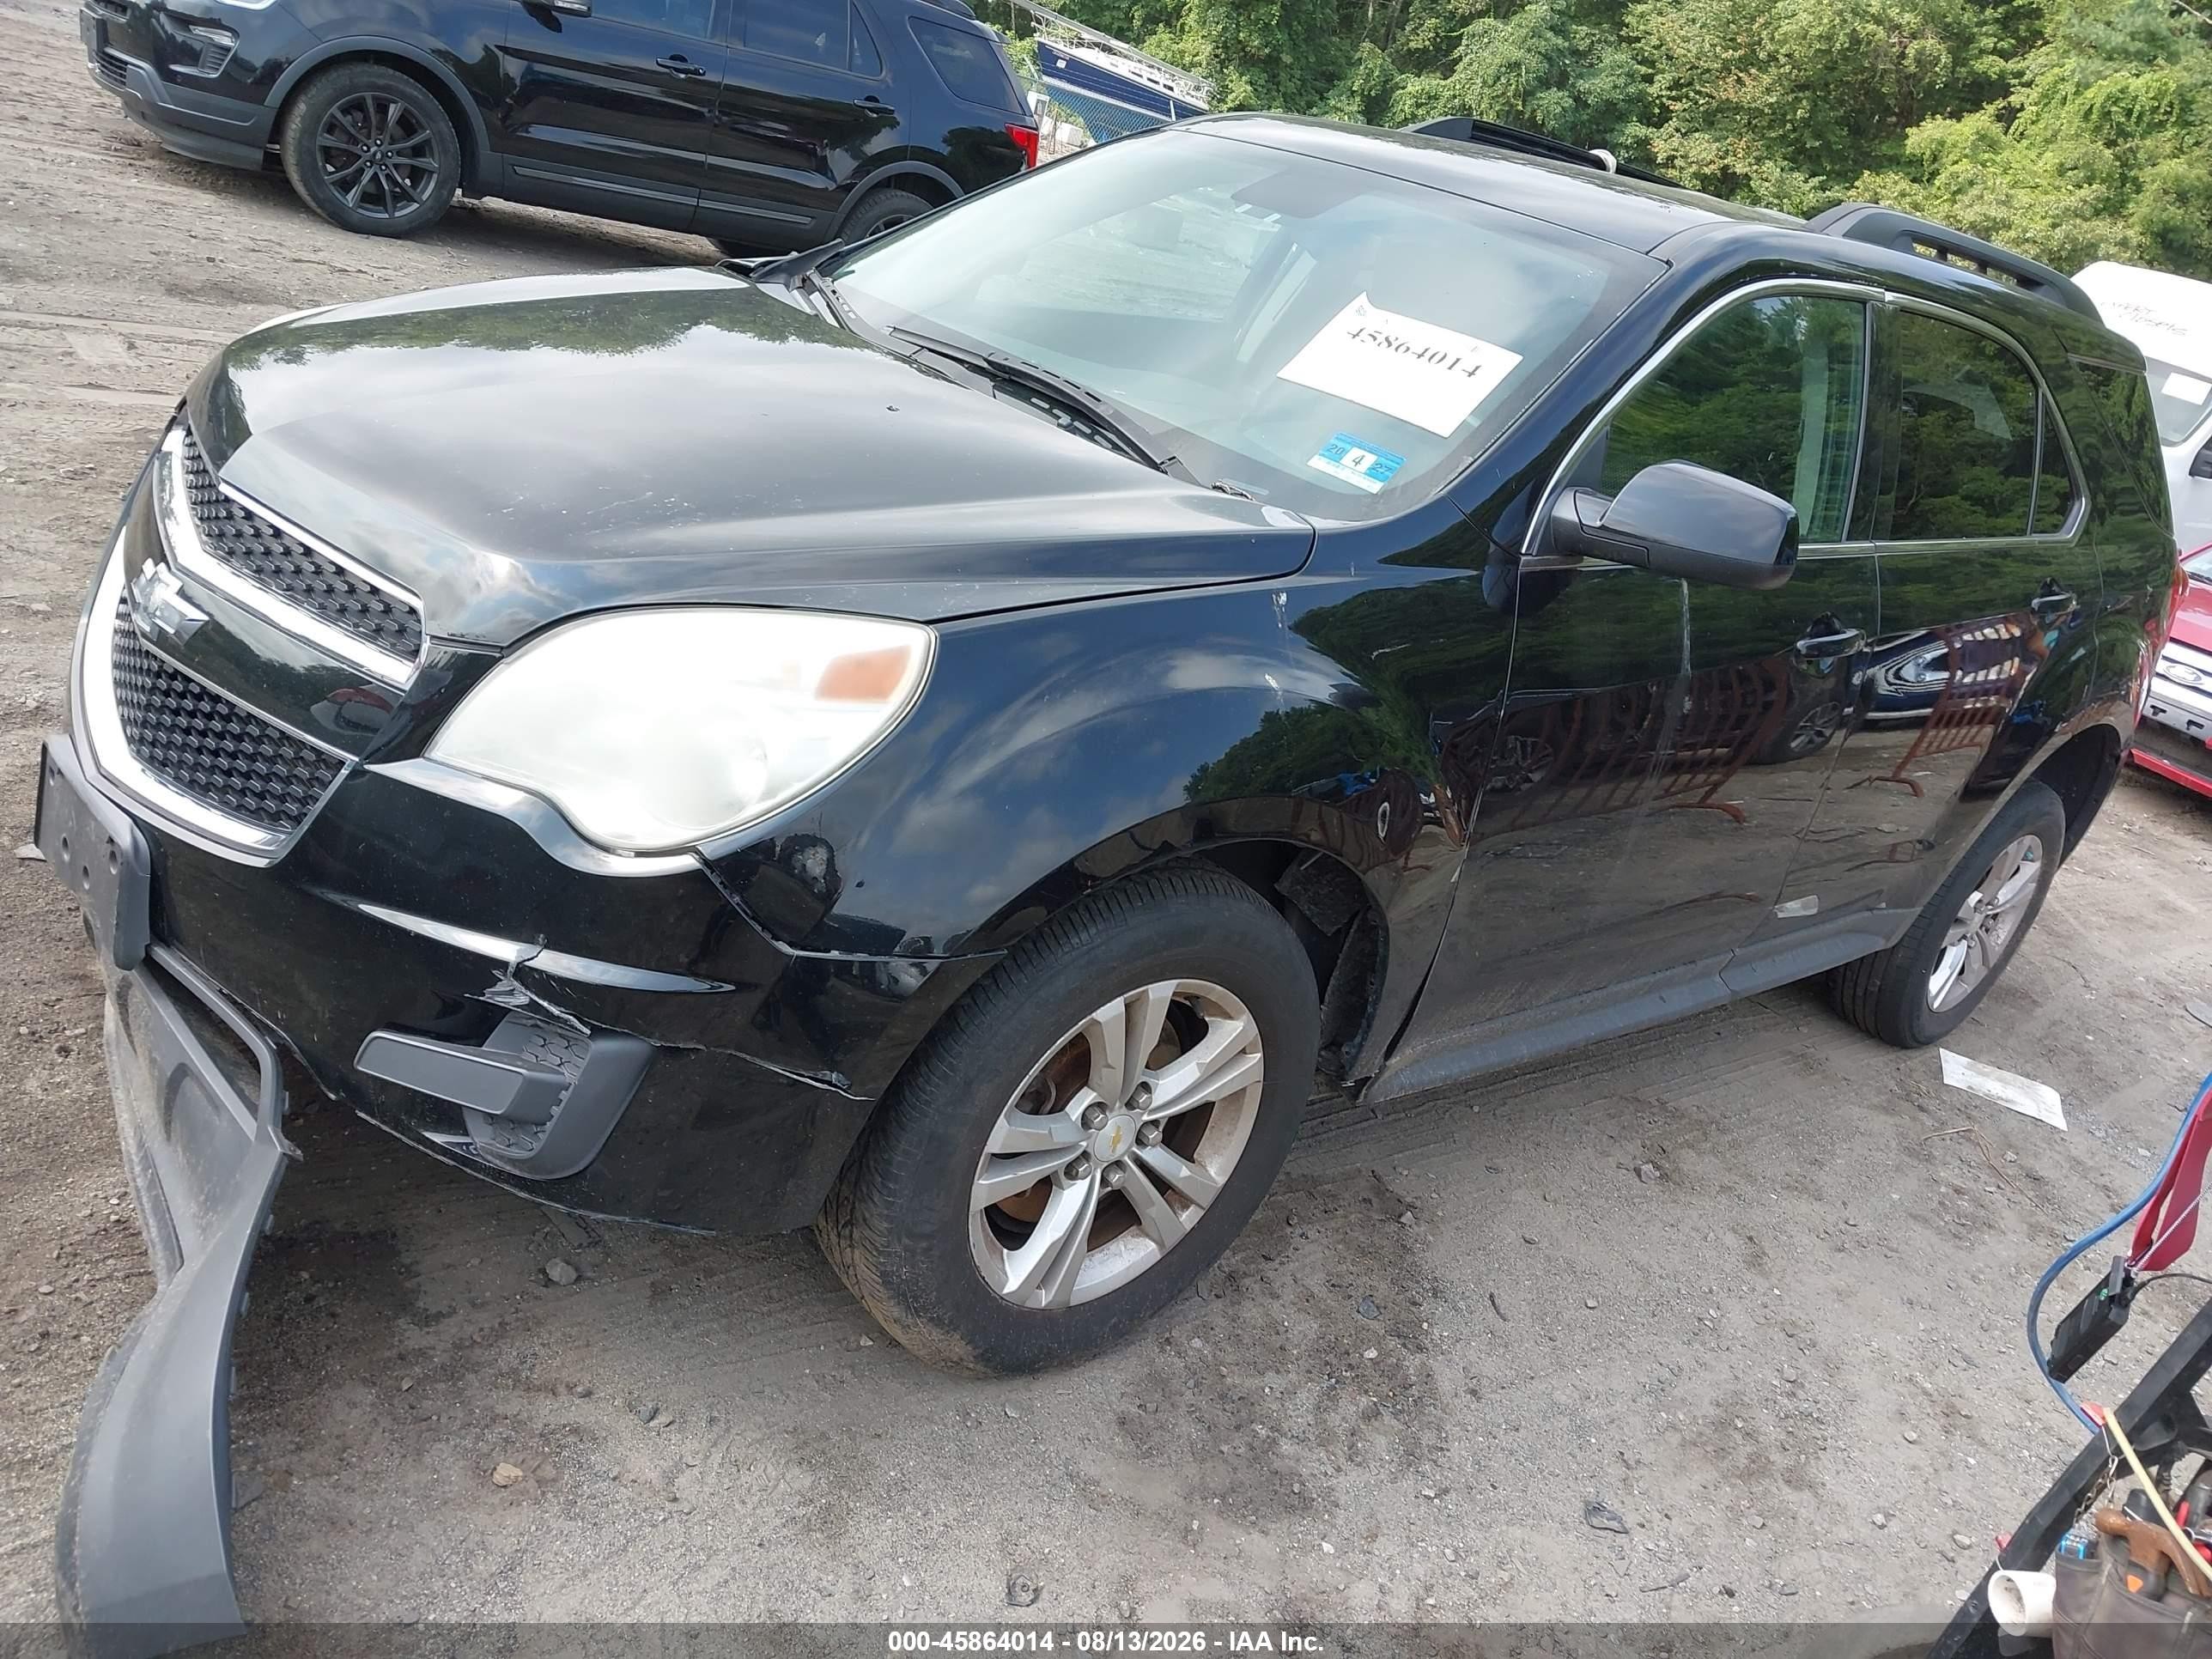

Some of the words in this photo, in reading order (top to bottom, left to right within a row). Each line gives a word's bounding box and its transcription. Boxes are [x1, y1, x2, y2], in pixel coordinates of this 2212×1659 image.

[1346, 327, 1482, 378] 45864014
[1326, 443, 1346, 456] 20
[1352, 453, 1366, 467] 4
[1371, 463, 1392, 475] 27
